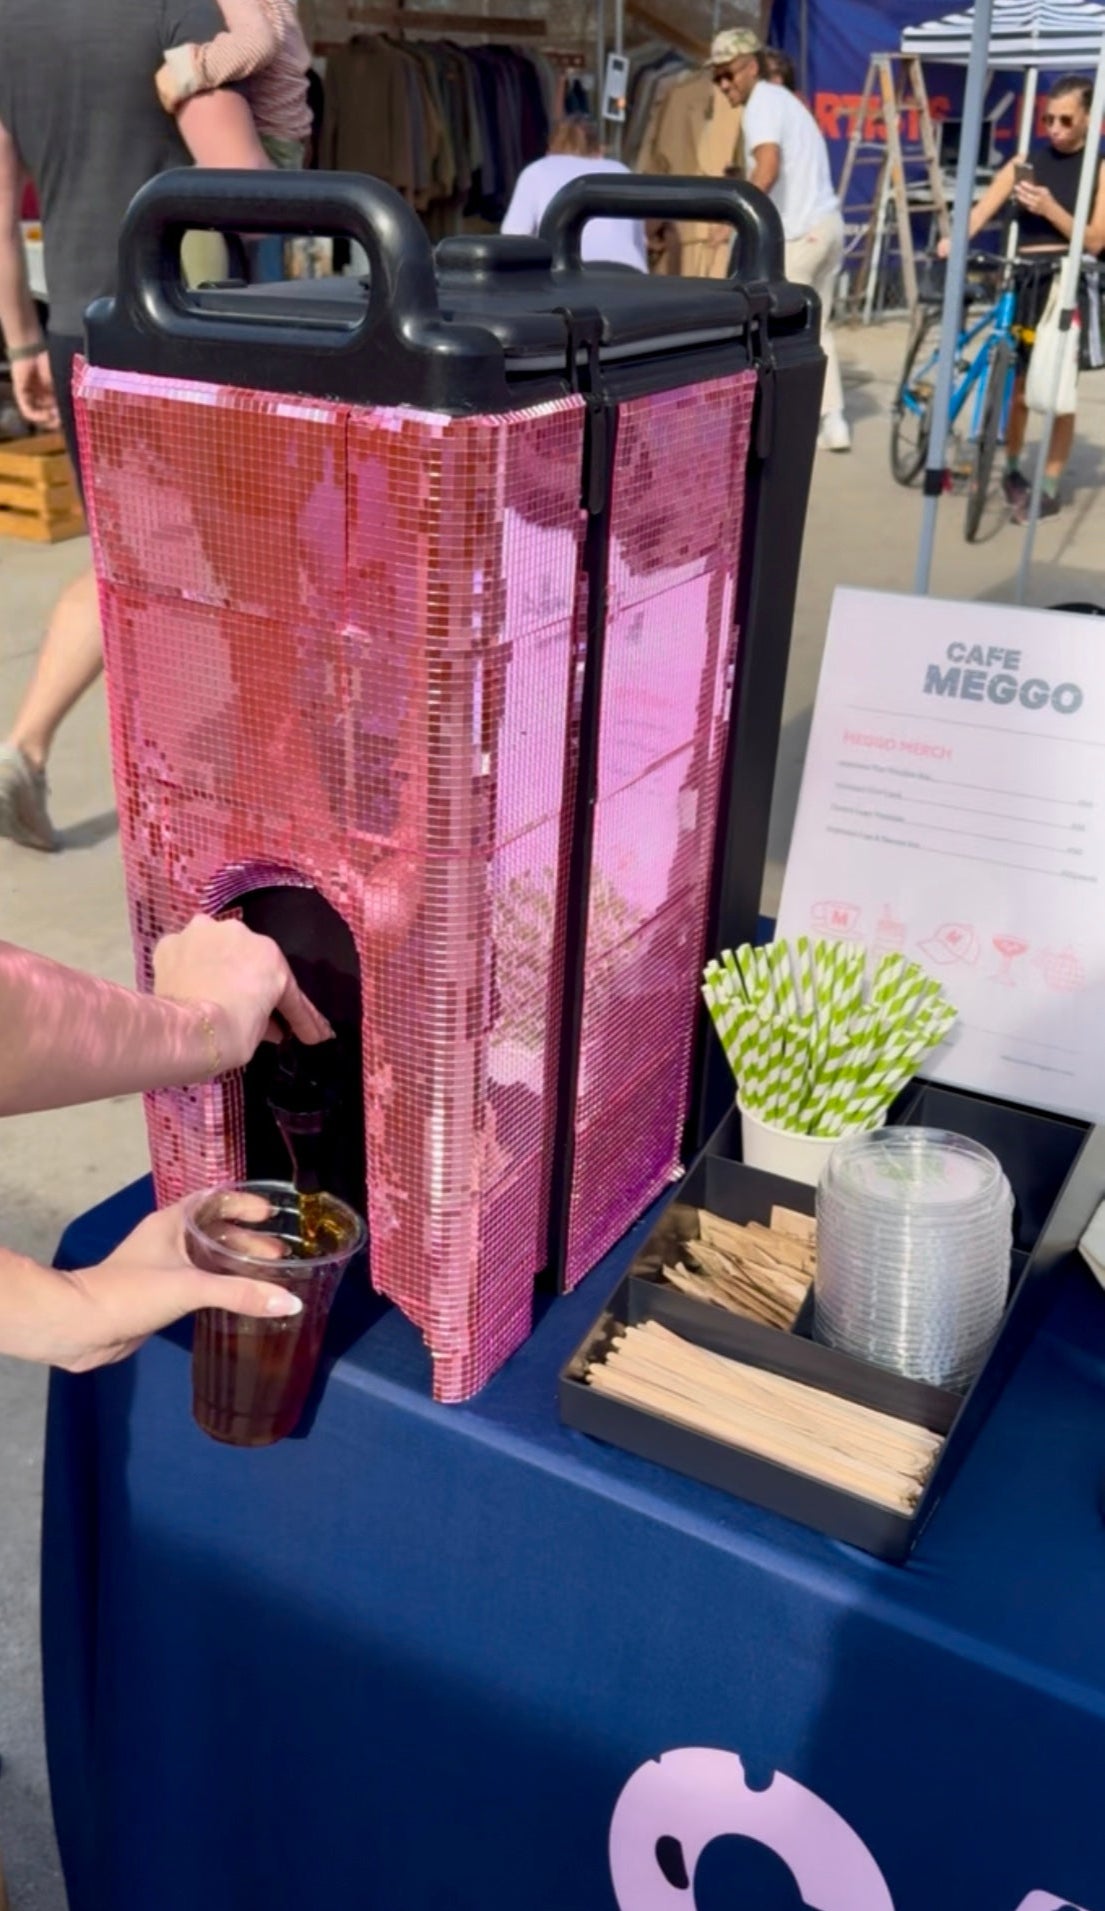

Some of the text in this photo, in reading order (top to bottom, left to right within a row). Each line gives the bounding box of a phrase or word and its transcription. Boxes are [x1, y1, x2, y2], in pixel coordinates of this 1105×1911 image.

[946, 642, 1021, 671] CAFE
[923, 664, 1083, 714] MEGGO
[899, 739, 952, 760] MERCH
